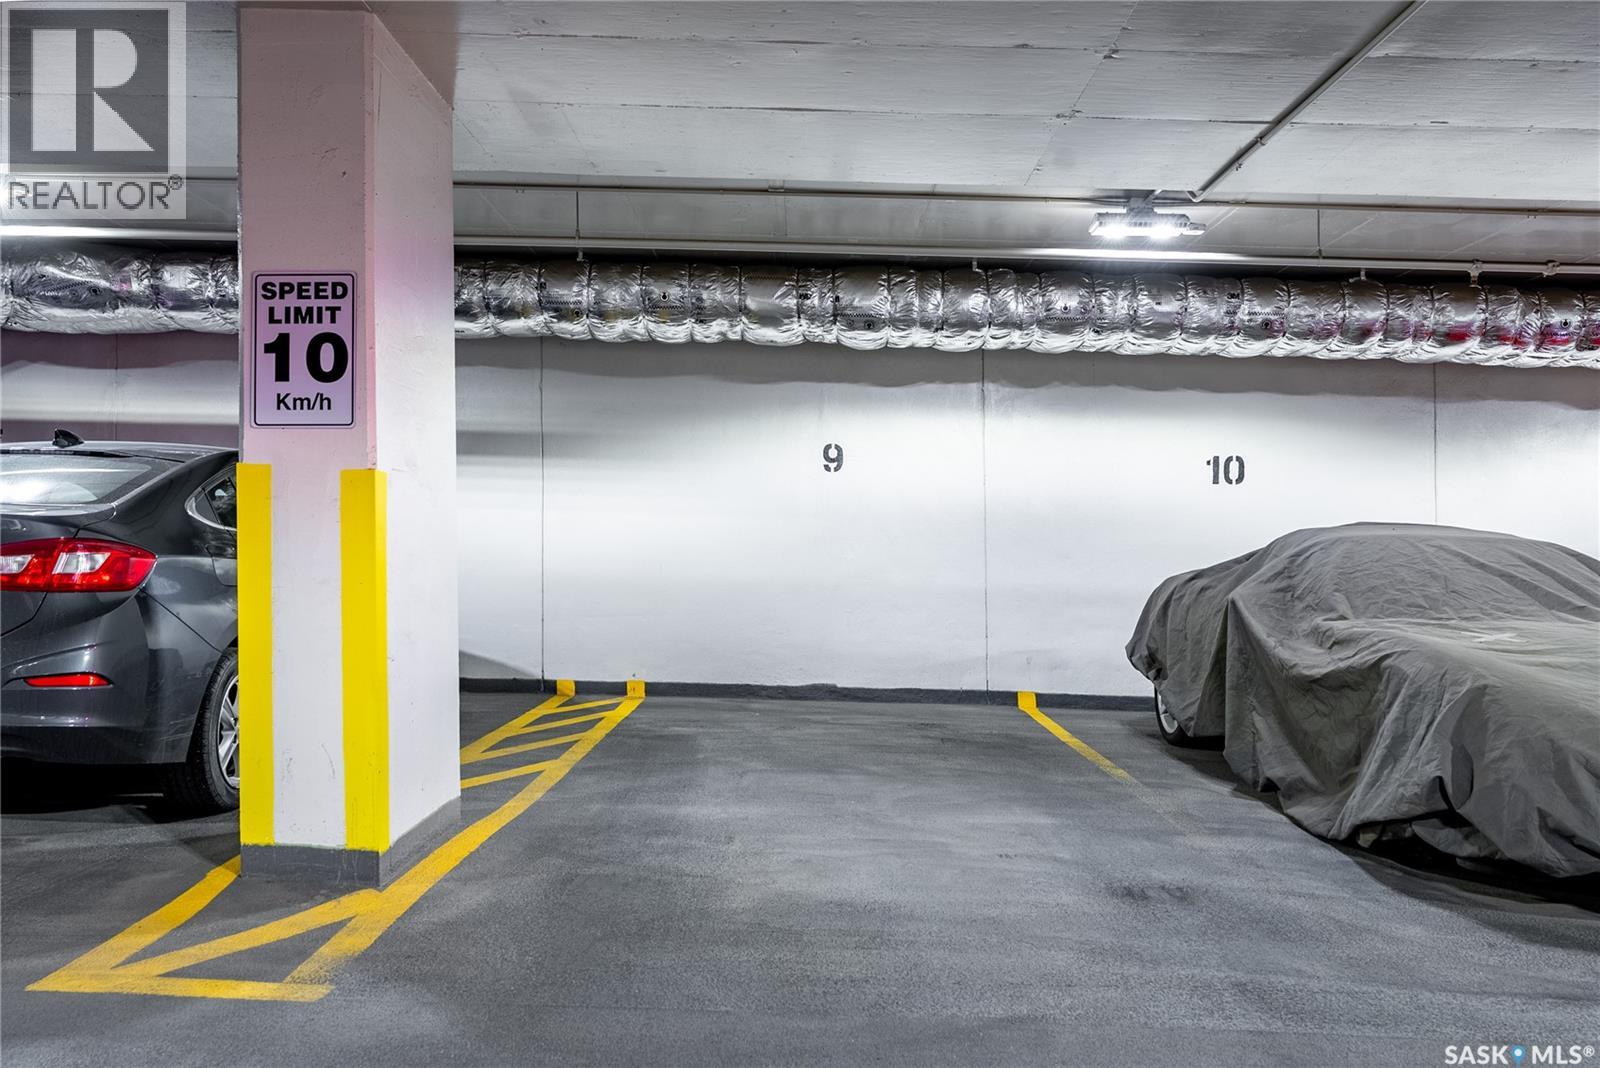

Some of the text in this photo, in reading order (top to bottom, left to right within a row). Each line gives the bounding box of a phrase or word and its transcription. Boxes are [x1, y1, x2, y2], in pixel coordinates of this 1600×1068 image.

[261, 281, 349, 300] SPEED
[268, 306, 342, 324] LIMIT
[263, 331, 349, 384] 10
[276, 392, 332, 411] Km/h
[822, 443, 844, 473] 9
[1206, 455, 1246, 485] 10
